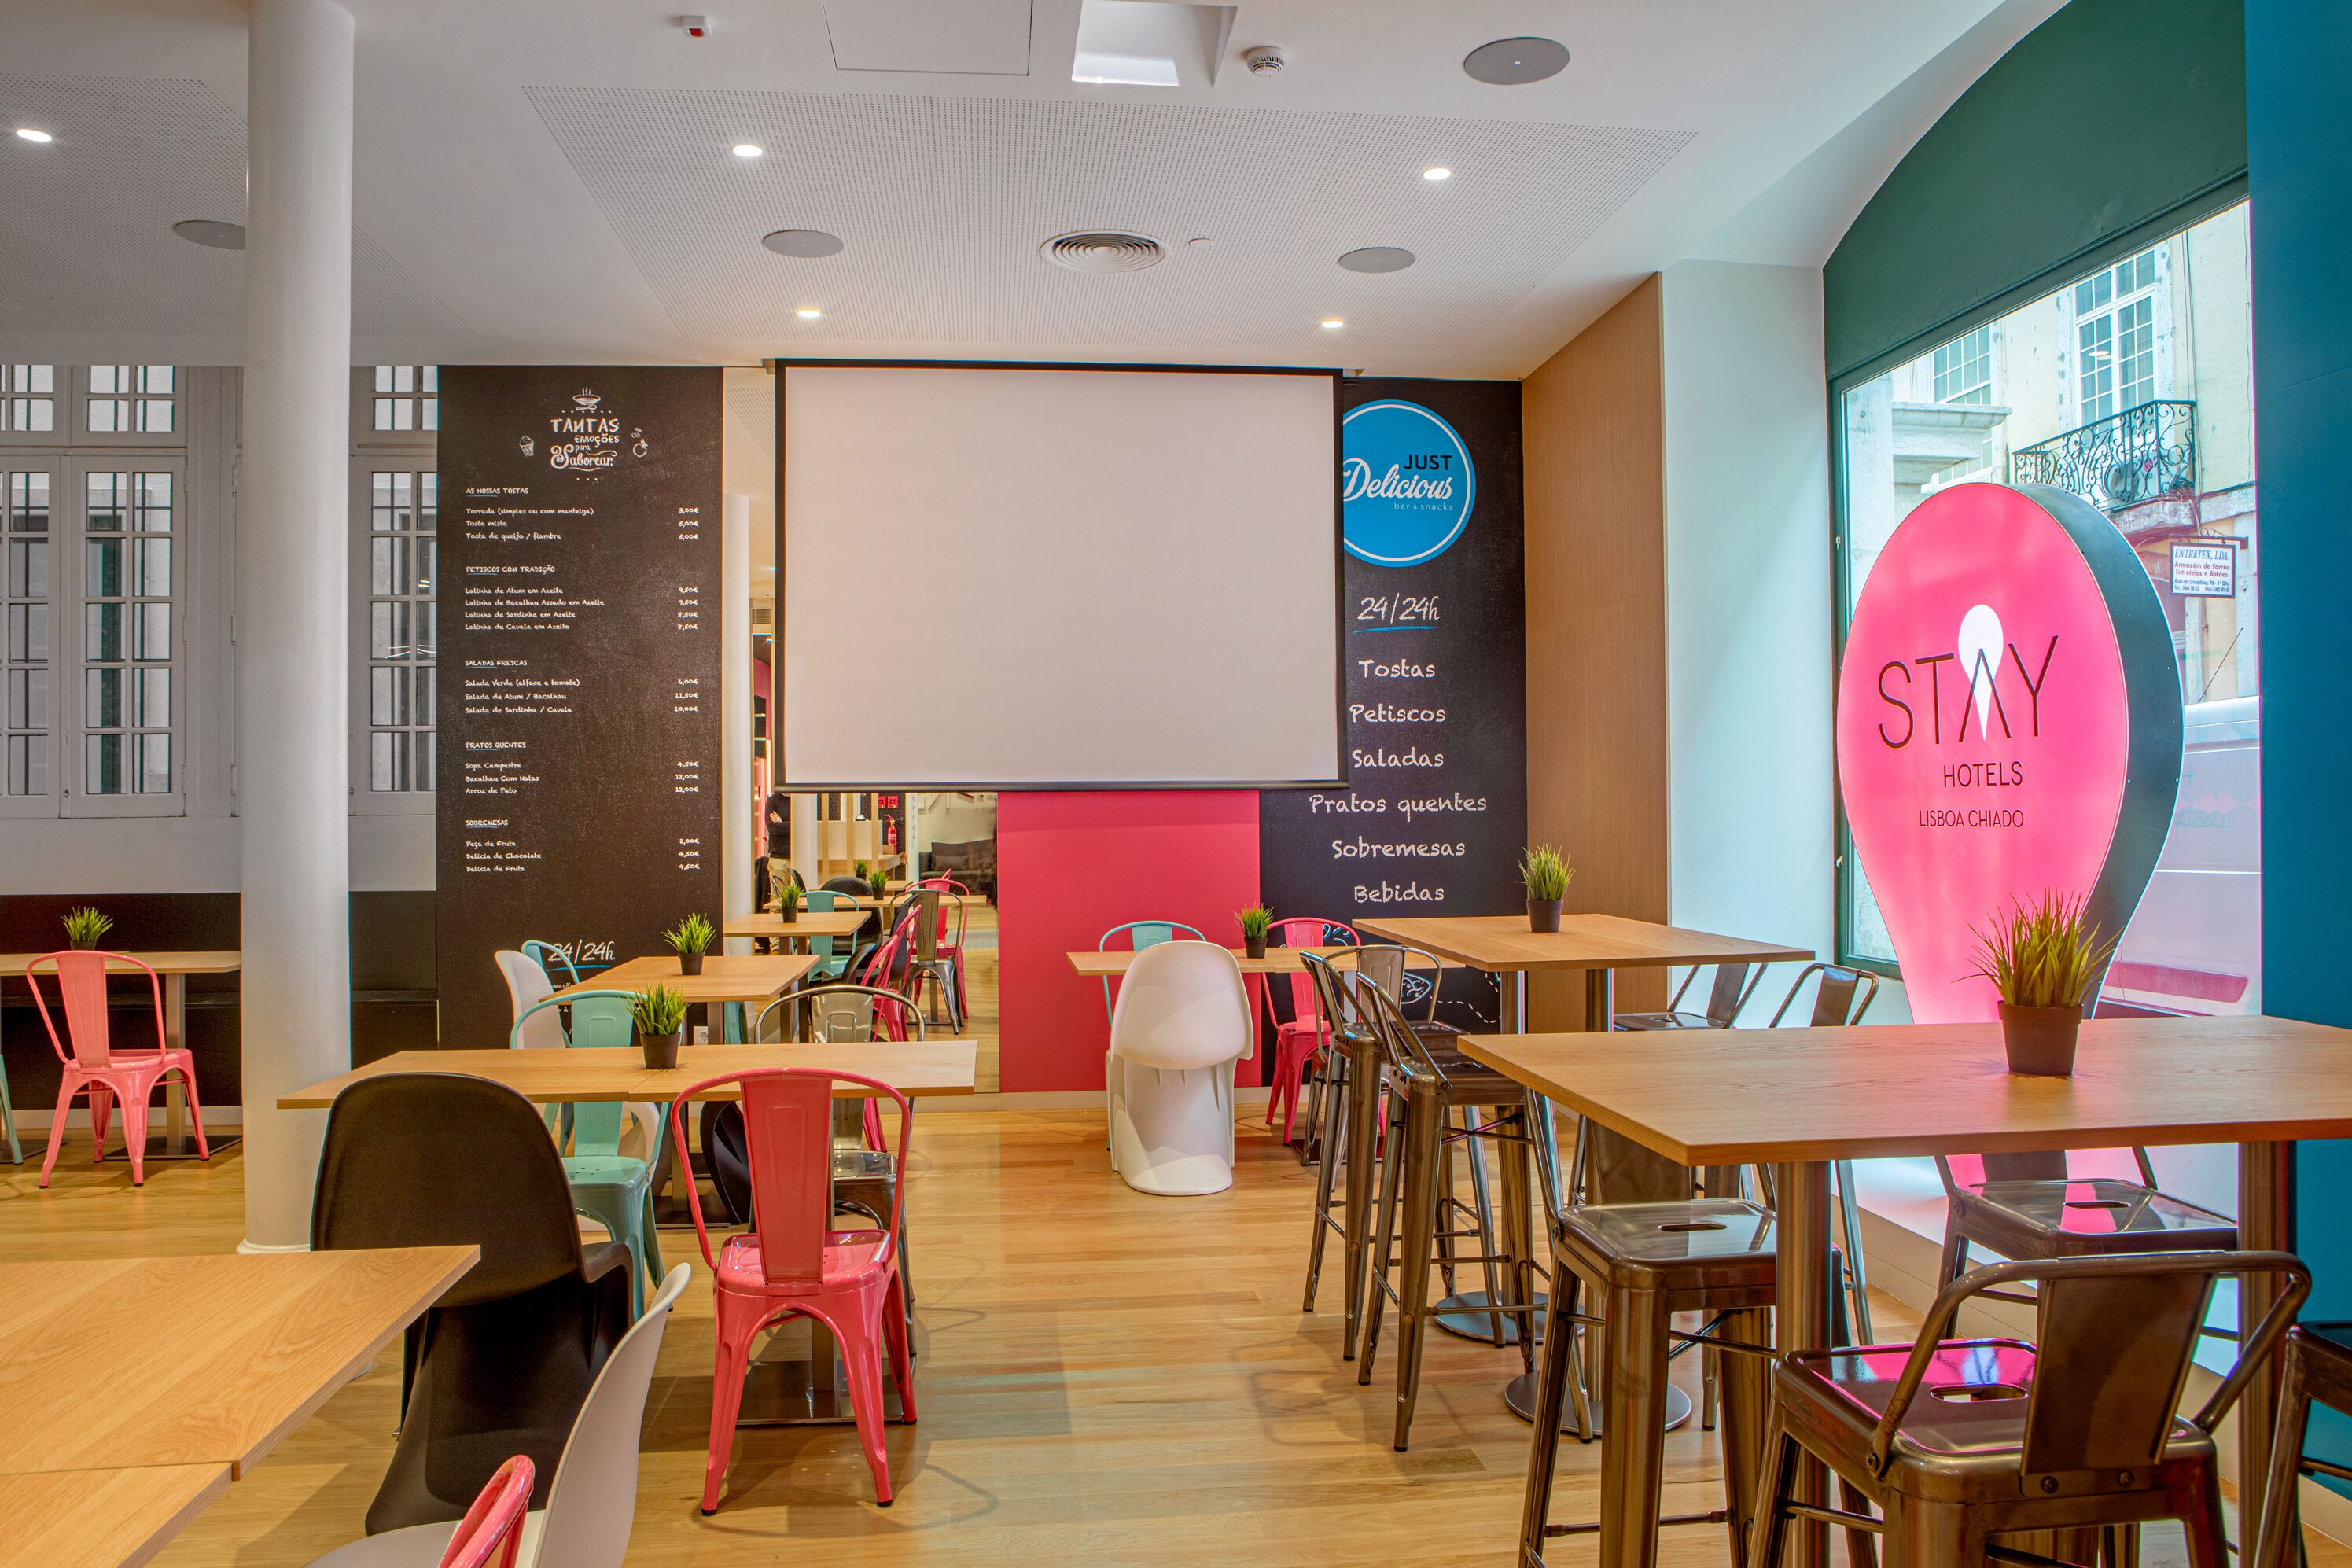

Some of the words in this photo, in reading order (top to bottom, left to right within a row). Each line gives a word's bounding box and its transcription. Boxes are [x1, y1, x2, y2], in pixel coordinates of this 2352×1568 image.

[550, 418, 620, 432] TANTAS
[574, 432, 620, 448] EMOÇÕES
[575, 444, 591, 454] para
[1403, 454, 1452, 471] JUST
[1343, 458, 1452, 502] Delicious
[497, 508, 526, 517] (simples
[1420, 502, 1453, 510] snacks
[501, 532, 524, 541] queijo
[533, 532, 561, 540] fiambre
[520, 564, 555, 575] TRADIÇÃO
[1357, 592, 1441, 624] 24/24h
[1358, 658, 1435, 678] Tostas
[516, 679, 542, 687] (alface
[1878, 635, 2059, 749] STAY
[1349, 703, 1445, 723] Petiscos
[1351, 746, 1444, 768] Saladas
[466, 763, 481, 771] Sopa
[1943, 760, 2023, 788] HOTELS
[1309, 793, 1386, 813] Pratos
[1397, 792, 1487, 823] quentes
[1919, 810, 1964, 828] LISBOA
[1967, 809, 2024, 828] CHIADO
[466, 841, 482, 849] Peça
[1331, 836, 1466, 859] Sobremesas
[1354, 880, 1444, 903] Bebidas
